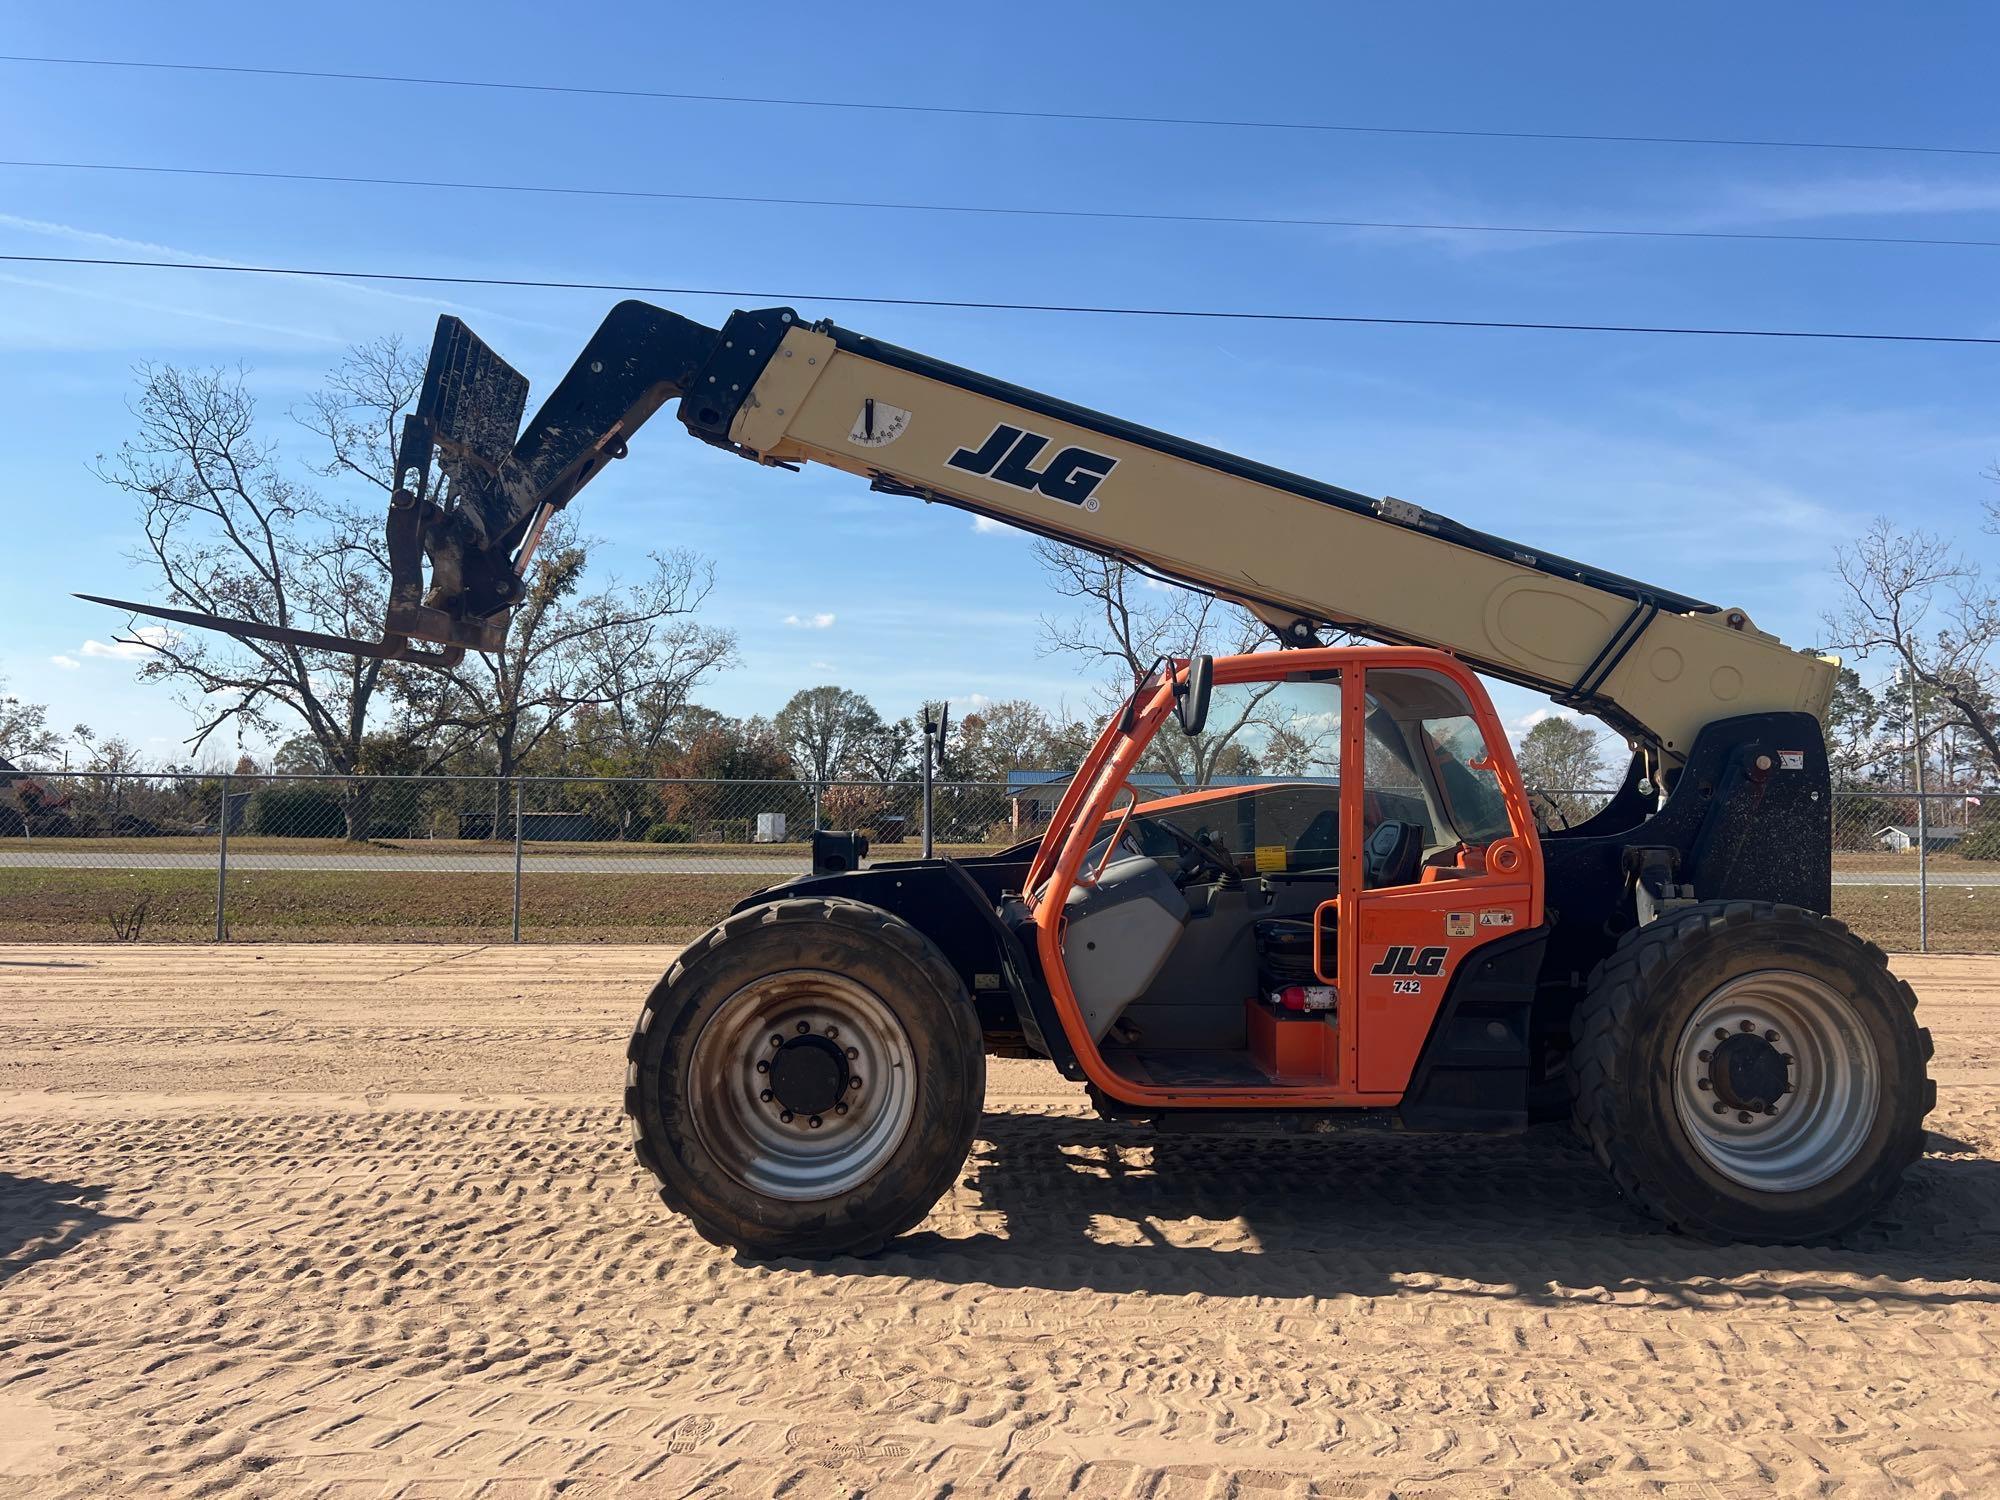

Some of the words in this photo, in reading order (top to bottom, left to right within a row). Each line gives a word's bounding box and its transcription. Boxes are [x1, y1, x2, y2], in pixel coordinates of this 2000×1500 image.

[944, 421, 1121, 508] JLG
[1370, 946, 1449, 976] JLG
[1393, 980, 1420, 993] 742
